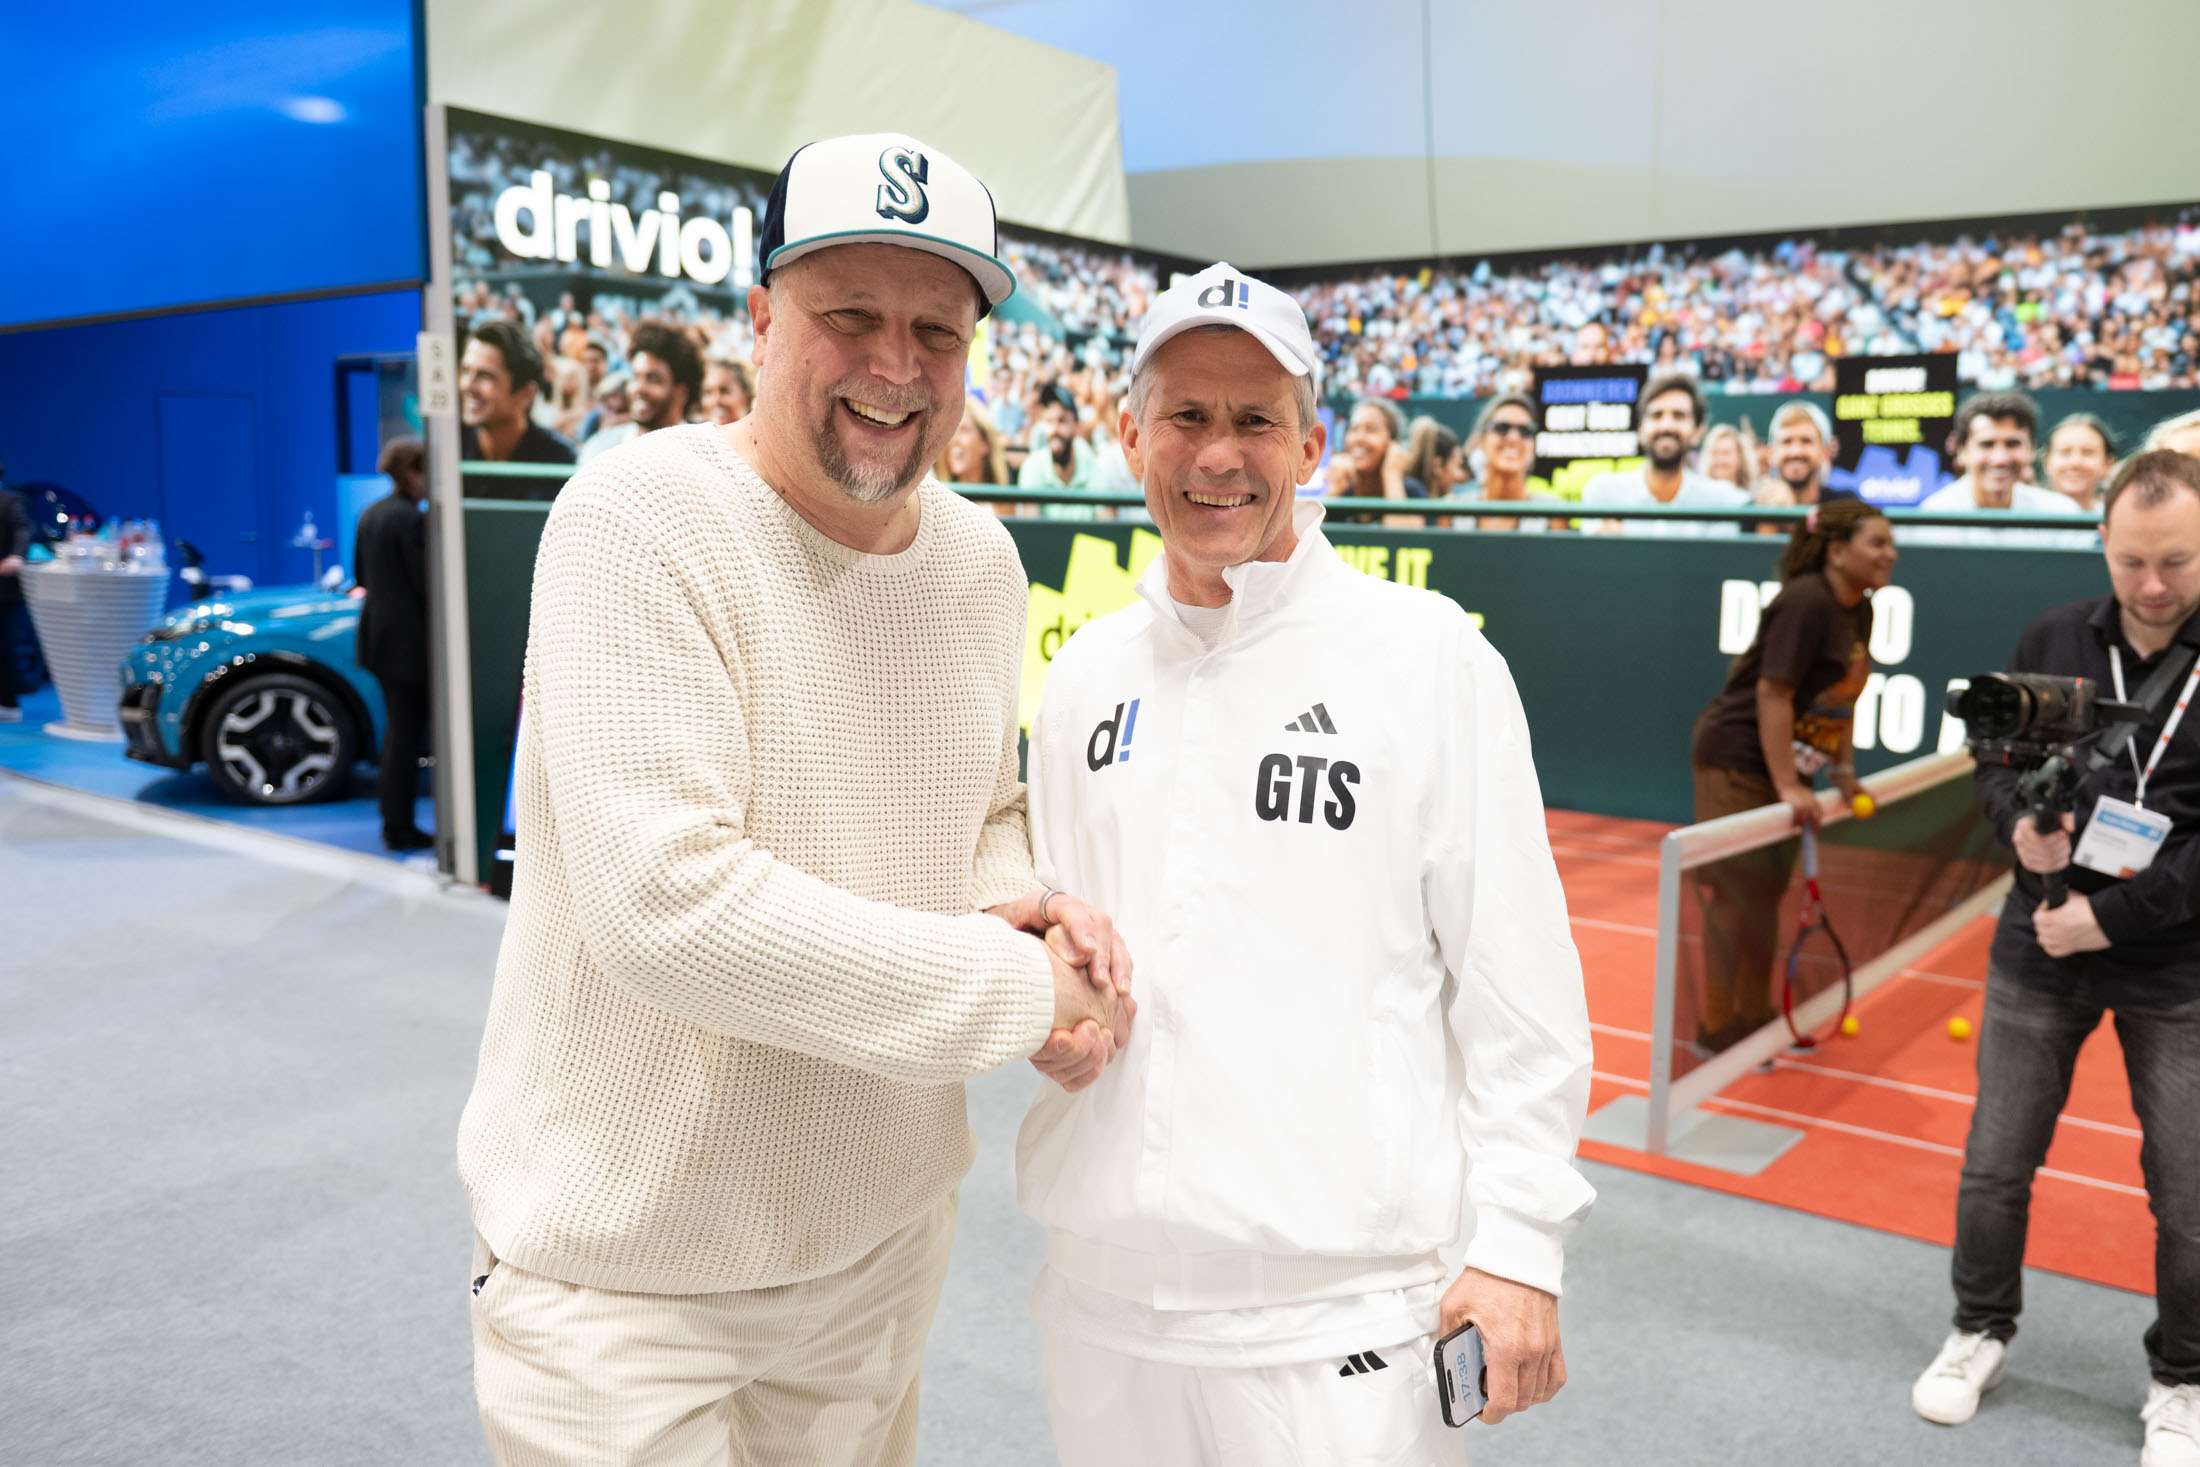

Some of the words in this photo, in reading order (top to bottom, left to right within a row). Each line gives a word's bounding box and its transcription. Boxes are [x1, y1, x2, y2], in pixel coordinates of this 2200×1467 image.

[876, 146, 929, 224] S
[494, 170, 753, 288] drivio!
[1197, 279, 1249, 310] d!
[1396, 547, 1440, 593] IT
[1087, 698, 1141, 772] d!
[1255, 753, 1361, 831] GTS
[1457, 1352, 1472, 1402] 17:38
